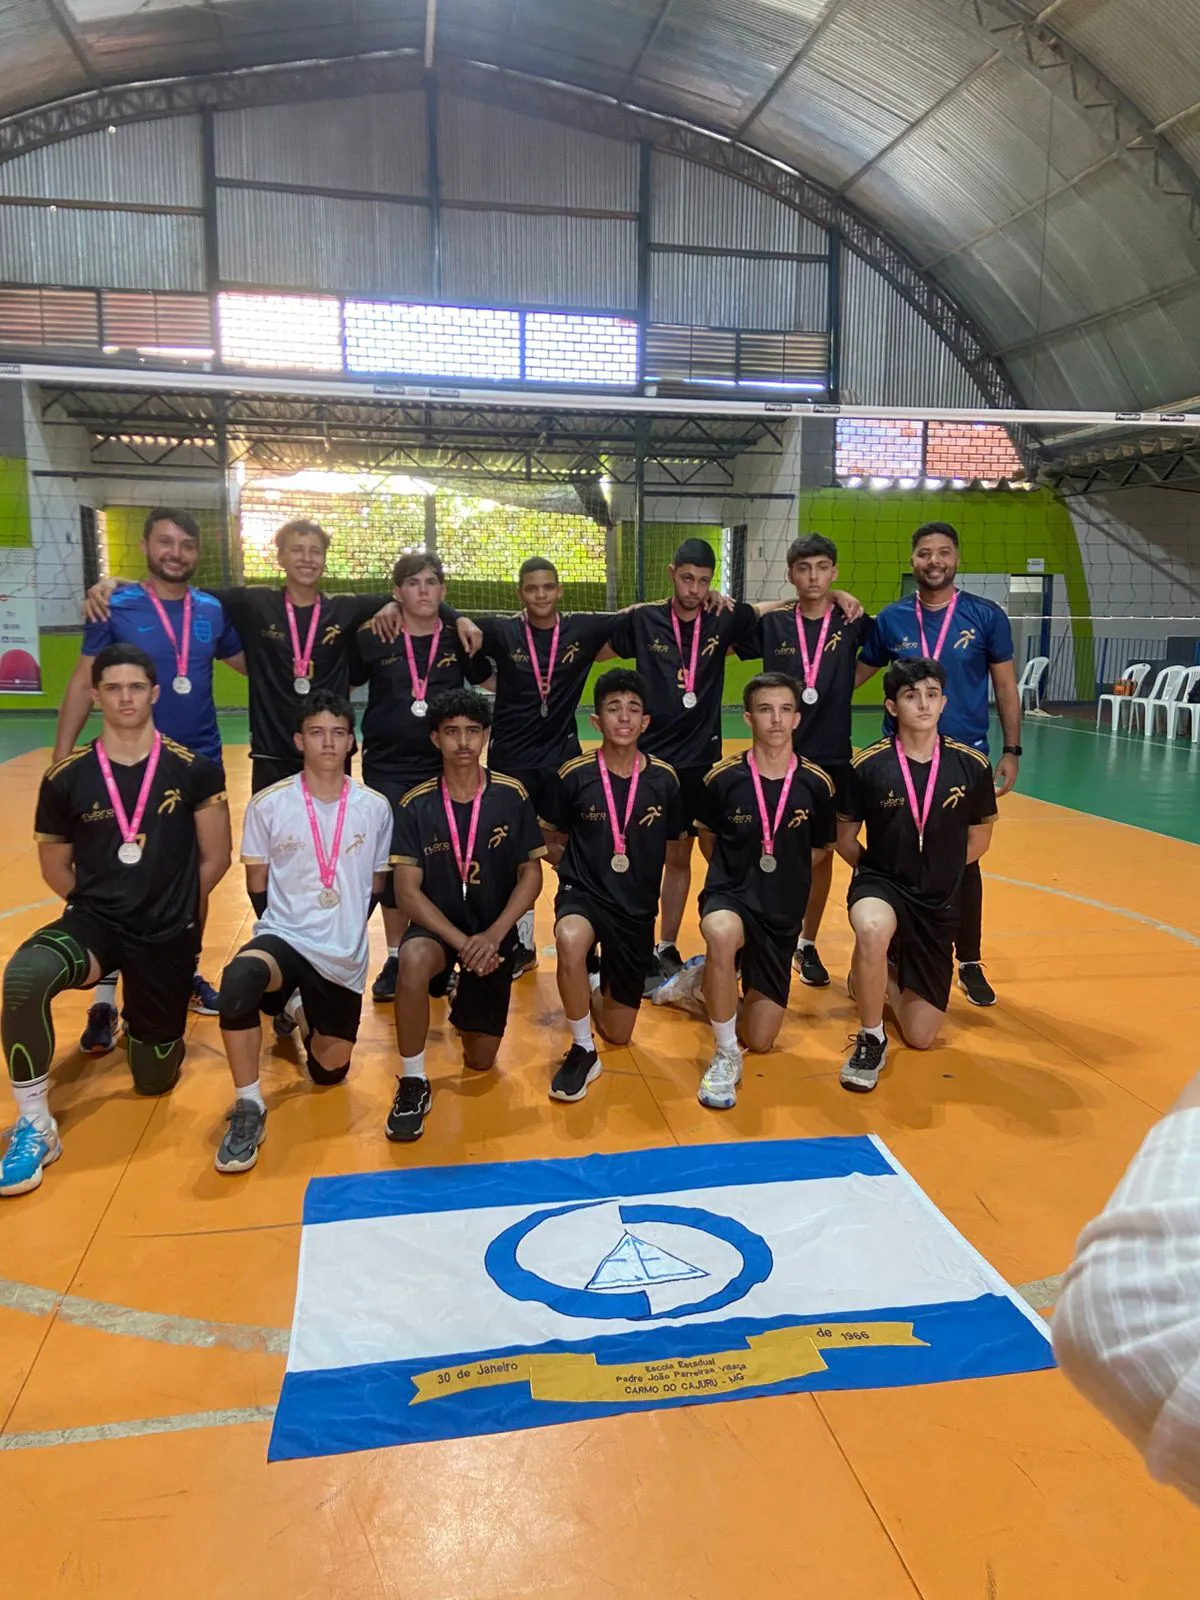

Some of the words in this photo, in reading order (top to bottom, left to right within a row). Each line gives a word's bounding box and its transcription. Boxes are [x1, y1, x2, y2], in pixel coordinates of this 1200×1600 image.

[816, 1327, 832, 1338] de
[840, 1331, 870, 1341] 1966
[437, 1372, 451, 1384] 30
[456, 1369, 471, 1380] de
[477, 1361, 518, 1376] Janeiro
[645, 1363, 675, 1373] Escola
[677, 1357, 716, 1369] Estadual
[616, 1373, 643, 1382] Padre
[648, 1372, 670, 1381] João
[673, 1367, 716, 1378] Parreiras
[625, 1385, 659, 1394] CARMO
[663, 1383, 677, 1392] DO
[681, 1378, 718, 1391] CAJURU
[728, 1372, 745, 1384] MG
